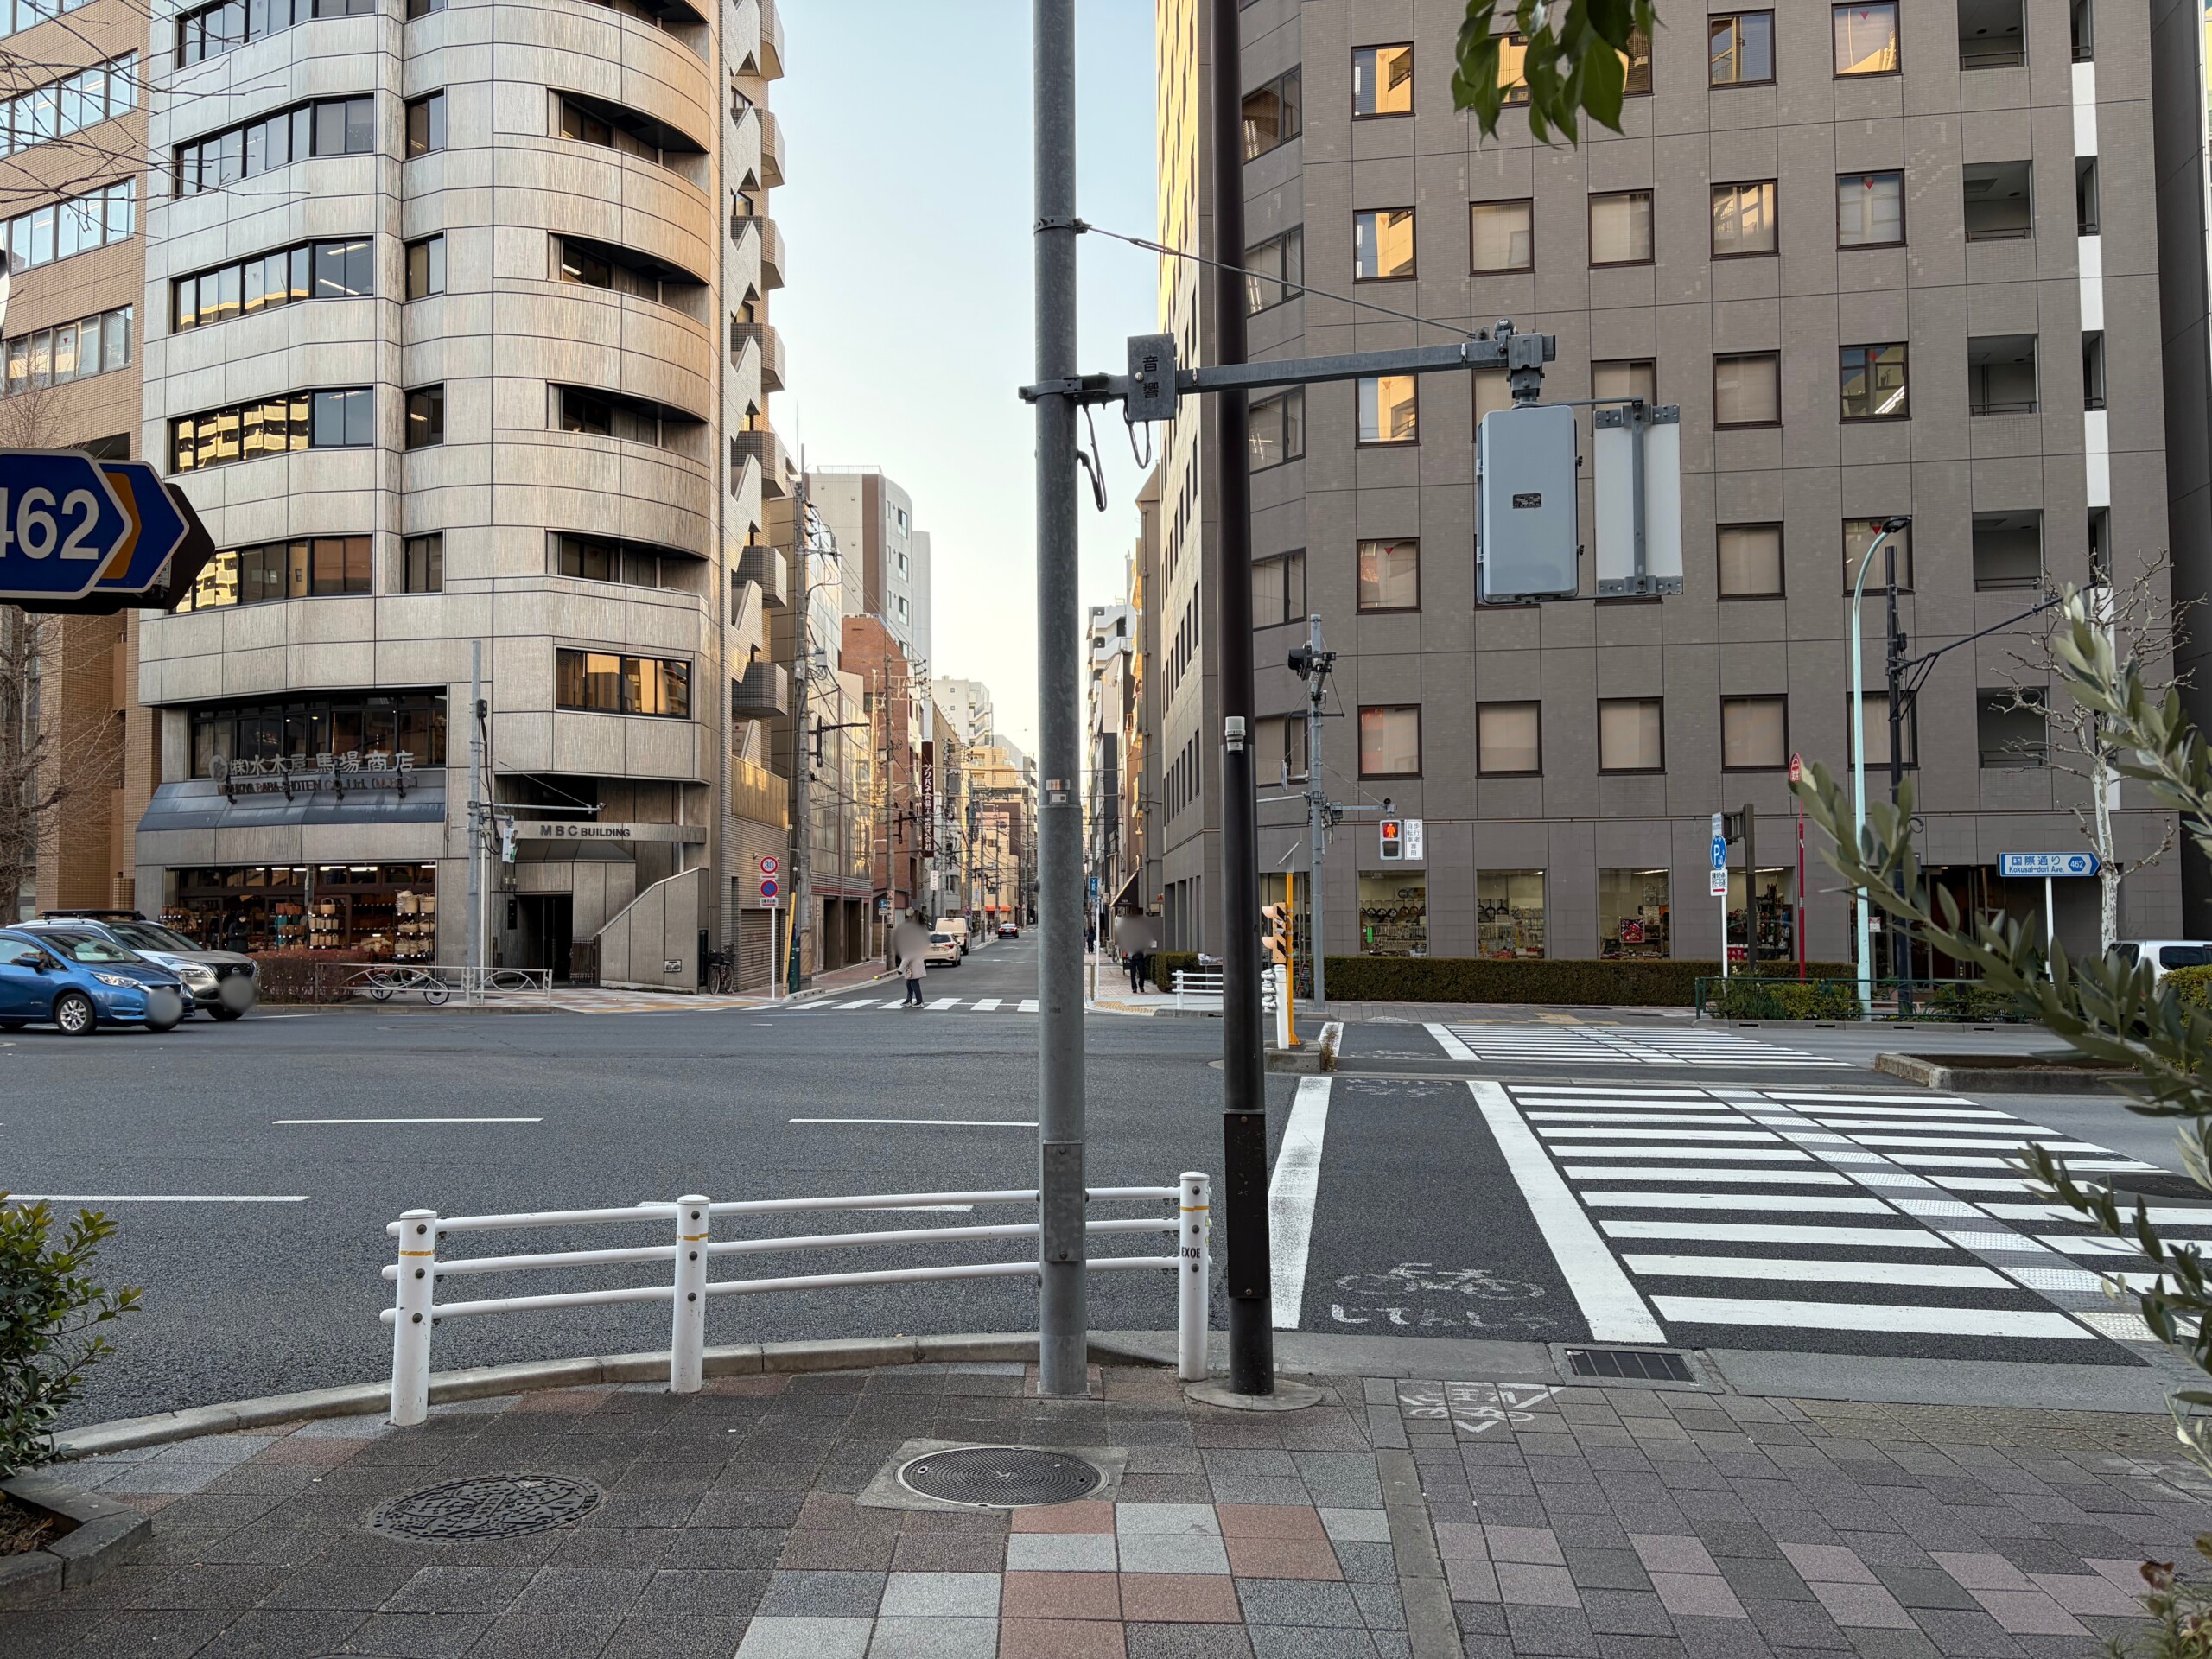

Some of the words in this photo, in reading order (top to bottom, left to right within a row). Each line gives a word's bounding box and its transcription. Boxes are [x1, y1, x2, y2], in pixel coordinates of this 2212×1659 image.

[1142, 355, 1159, 398] 音響
[581, 828, 631, 837] BUILDING
[764, 861, 775, 869] 30
[2012, 855, 2061, 866] 国際通り
[2069, 860, 2084, 868] 462
[1181, 1246, 1201, 1259] EXOE
